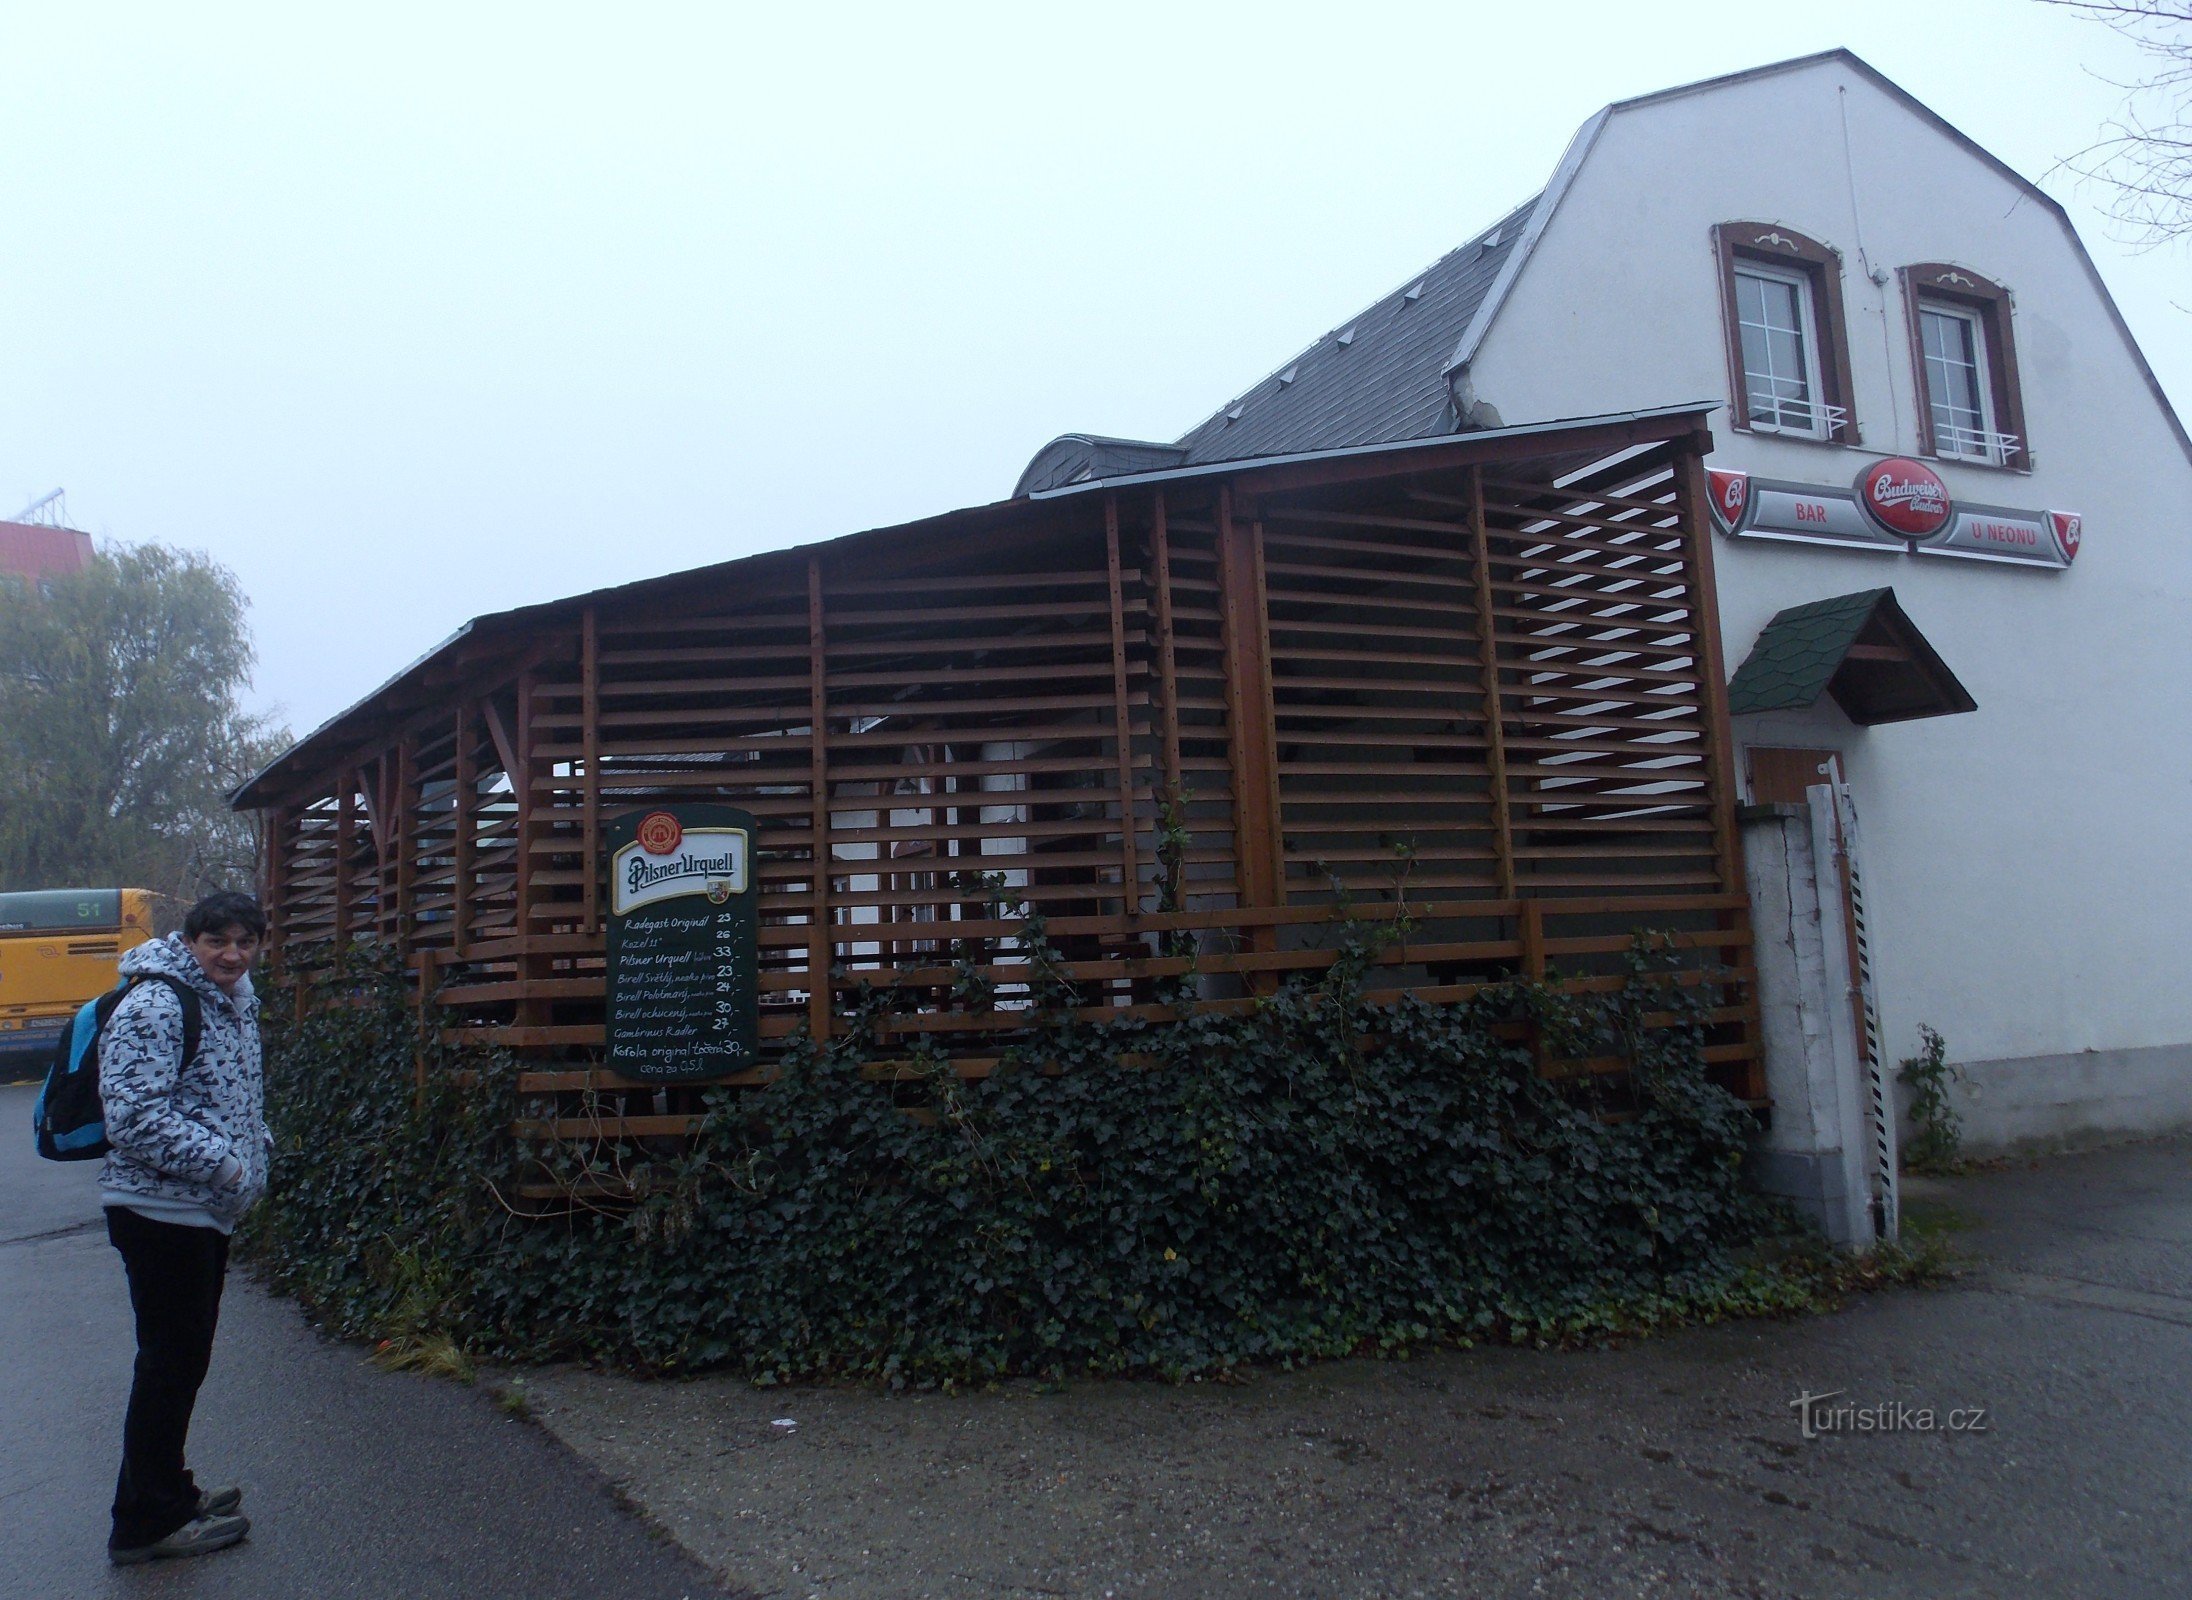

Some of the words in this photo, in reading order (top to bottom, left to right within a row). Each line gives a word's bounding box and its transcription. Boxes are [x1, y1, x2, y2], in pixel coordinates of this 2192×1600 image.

[1874, 474, 1945, 501] Budweiser
[1795, 502, 1827, 524] BAR
[1971, 521, 1982, 539] U
[1987, 523, 2037, 546] NEONU
[628, 856, 683, 894] Pilsner
[681, 852, 733, 879] Urquell
[77, 903, 101, 917] 51
[624, 917, 669, 934] Radegast
[621, 938, 647, 949] Kozel
[620, 954, 653, 966] Pilsner
[655, 951, 692, 968] Urquell
[617, 972, 643, 984] Birell
[616, 990, 642, 1002] Birell
[615, 1008, 642, 1019] Birell
[614, 1027, 664, 1038] Gambrinus
[665, 1025, 698, 1036] Radler
[613, 1043, 647, 1057] Kofola
[640, 1063, 663, 1074] cena
